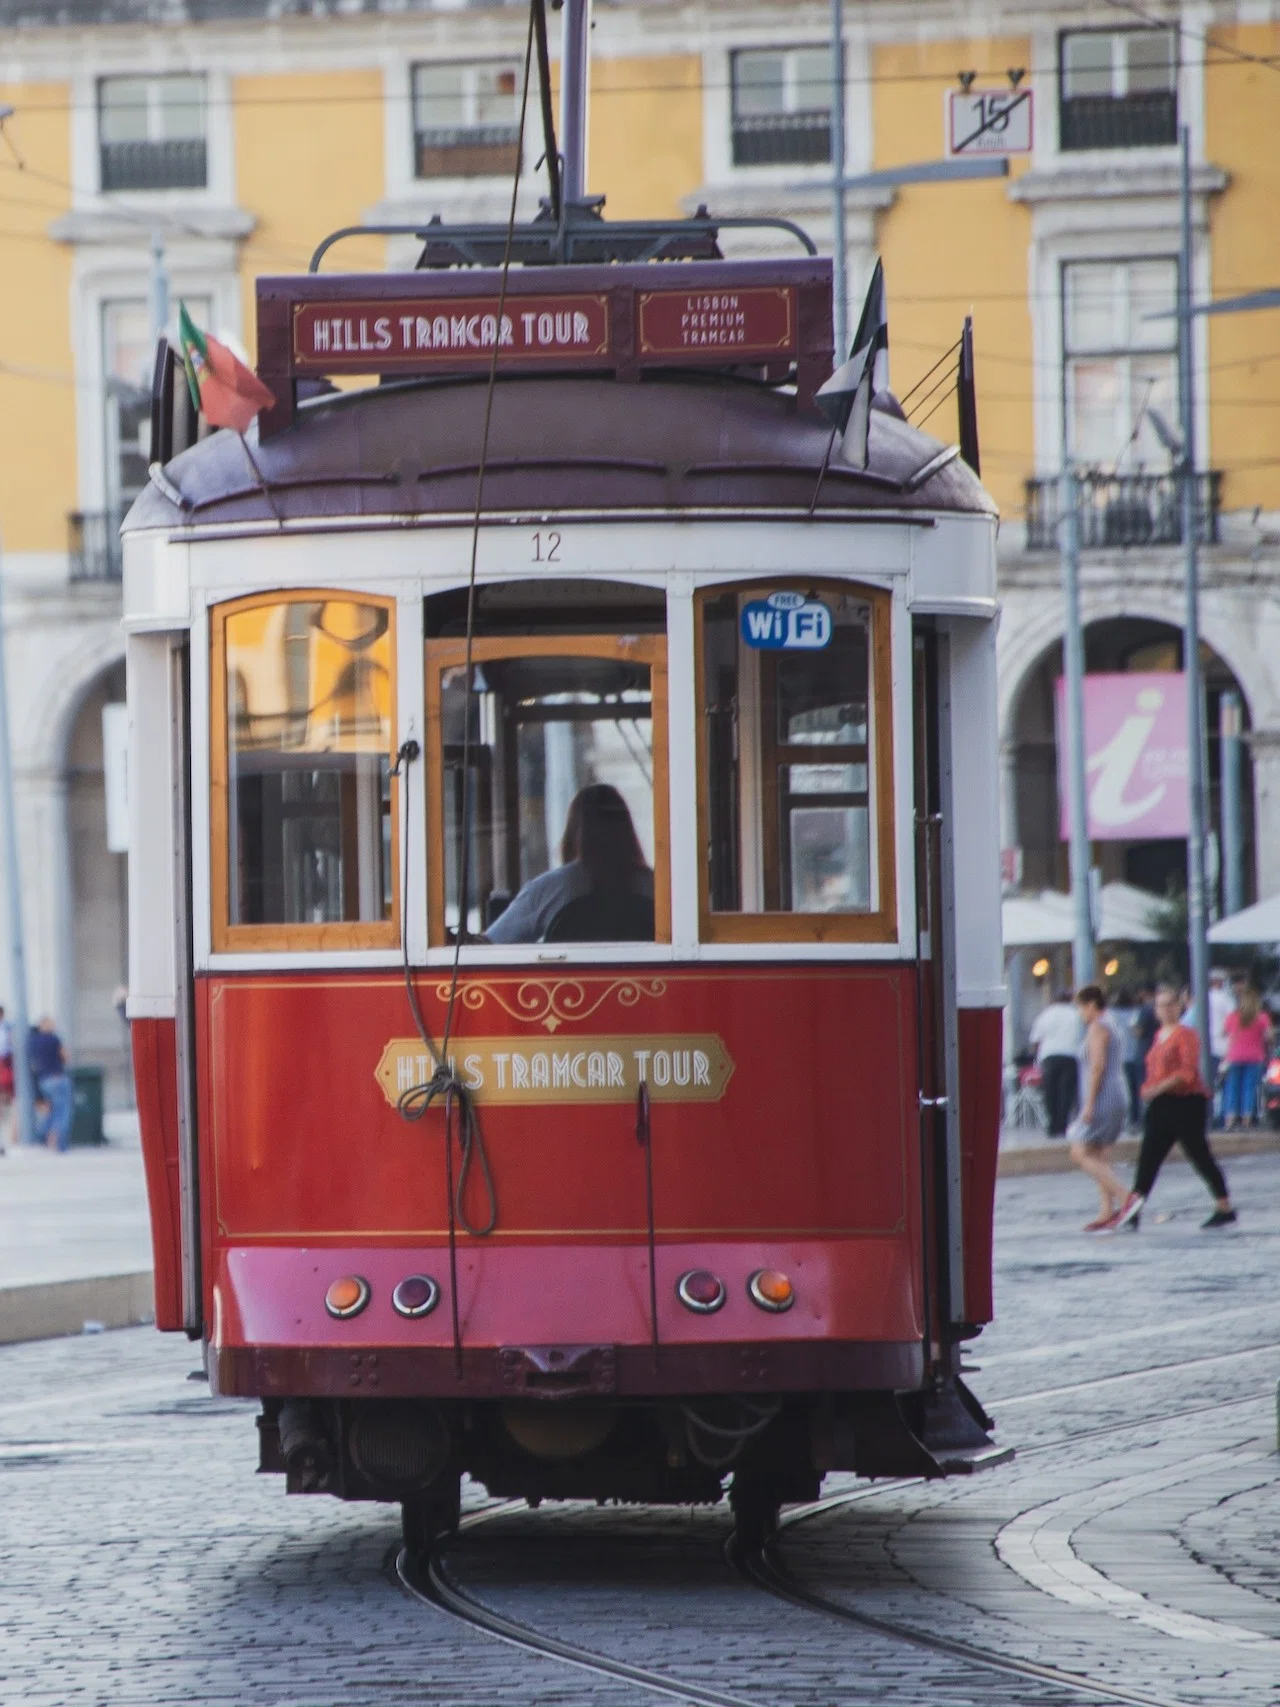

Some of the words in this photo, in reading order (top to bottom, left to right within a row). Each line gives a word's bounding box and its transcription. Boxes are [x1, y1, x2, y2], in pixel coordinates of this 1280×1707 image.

[972, 96, 1010, 133] 15
[687, 296, 738, 311] LISBON
[313, 317, 392, 351] HILLS
[399, 314, 514, 349] TRAMCAR
[521, 310, 590, 346] TOUR
[681, 312, 745, 328] PREMIUM
[681, 329, 745, 345] TRAMCAR
[531, 531, 561, 562] 12
[492, 1051, 625, 1089] TRAMCAR
[633, 1049, 711, 1087] TOUR
